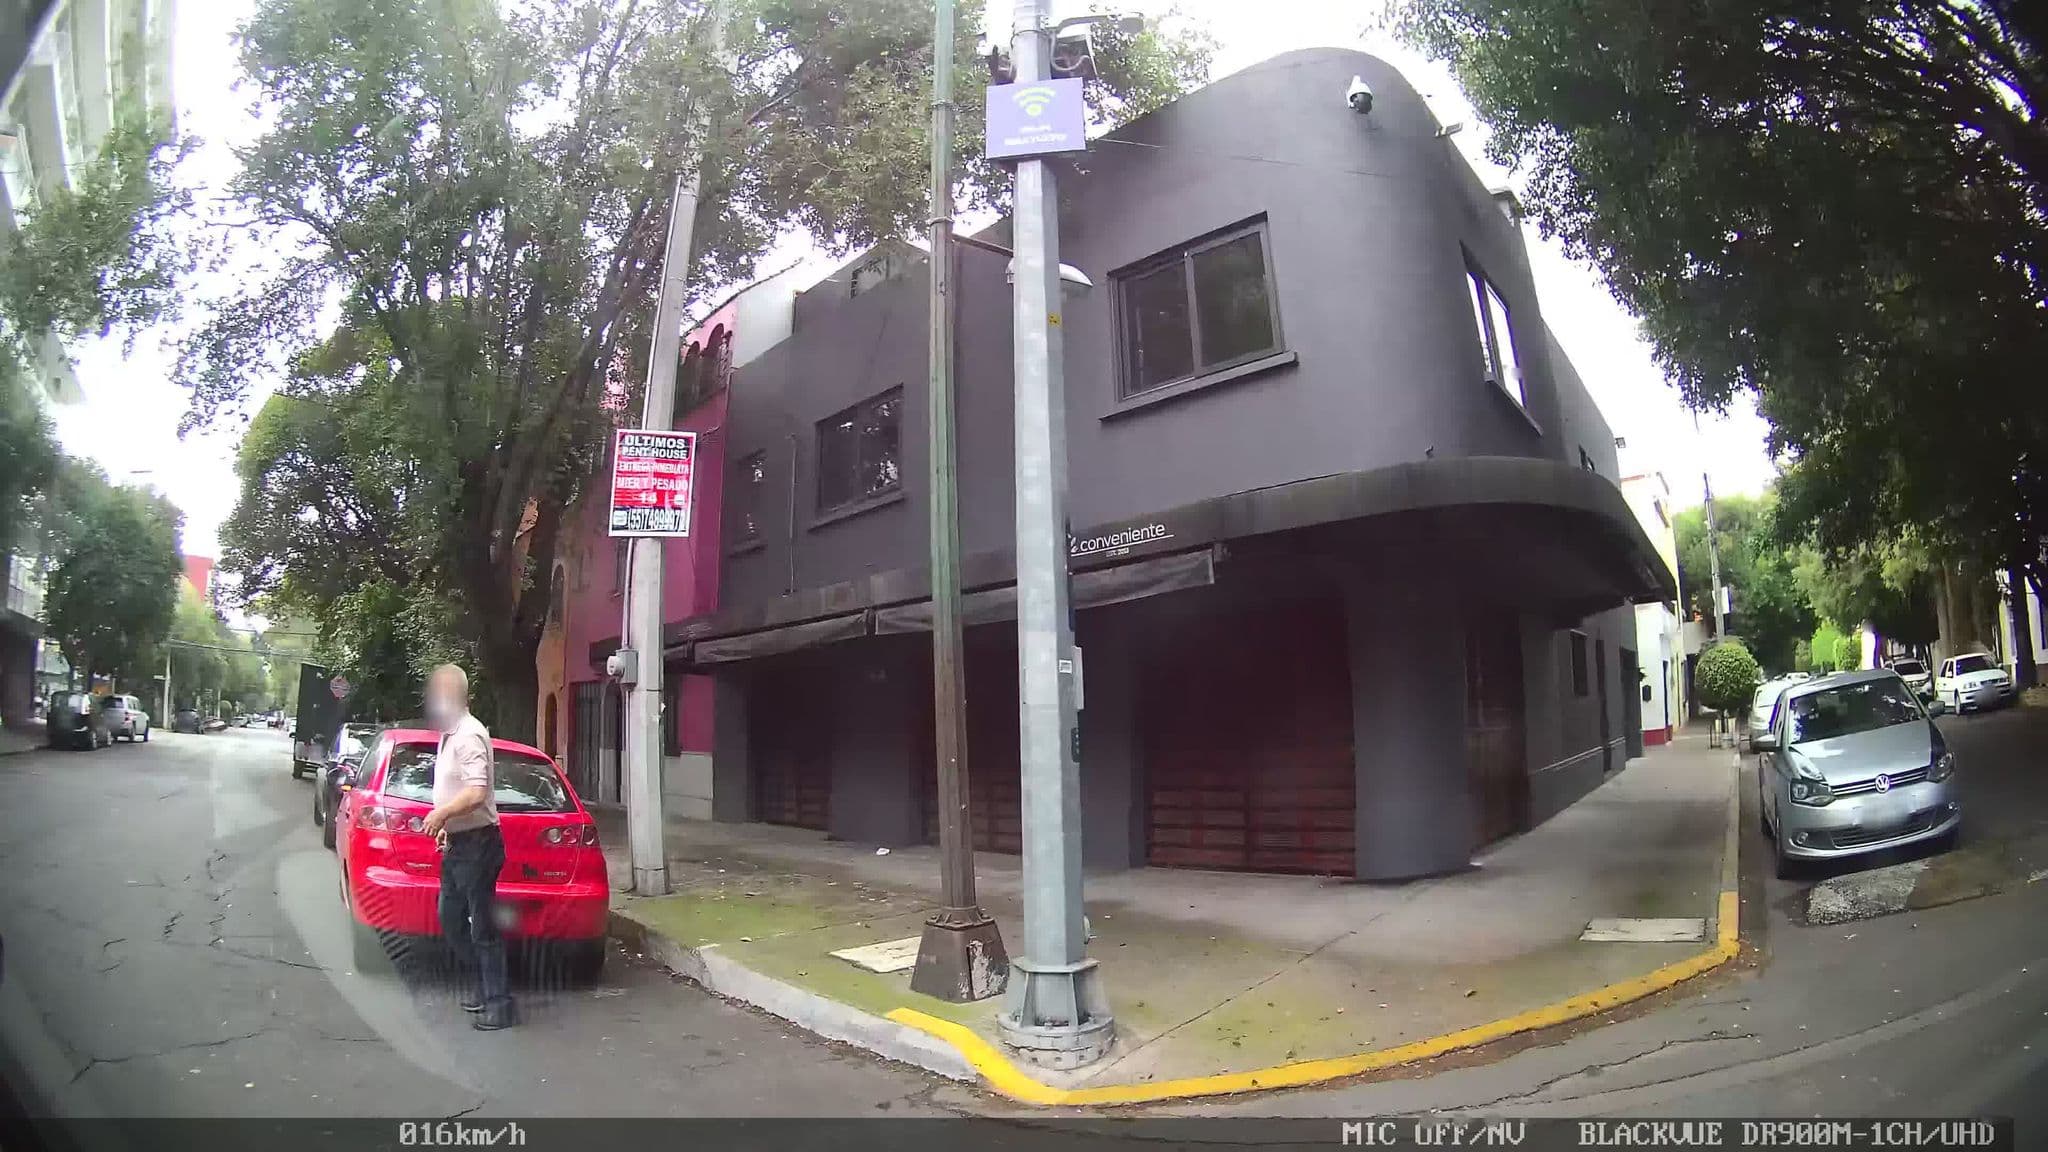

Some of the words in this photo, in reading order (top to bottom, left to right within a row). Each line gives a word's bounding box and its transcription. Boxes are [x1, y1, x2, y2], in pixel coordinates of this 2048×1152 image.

[652, 448, 688, 459] HOUSE
[652, 478, 688, 491] PESADO
[1080, 523, 1165, 552] conveniente
